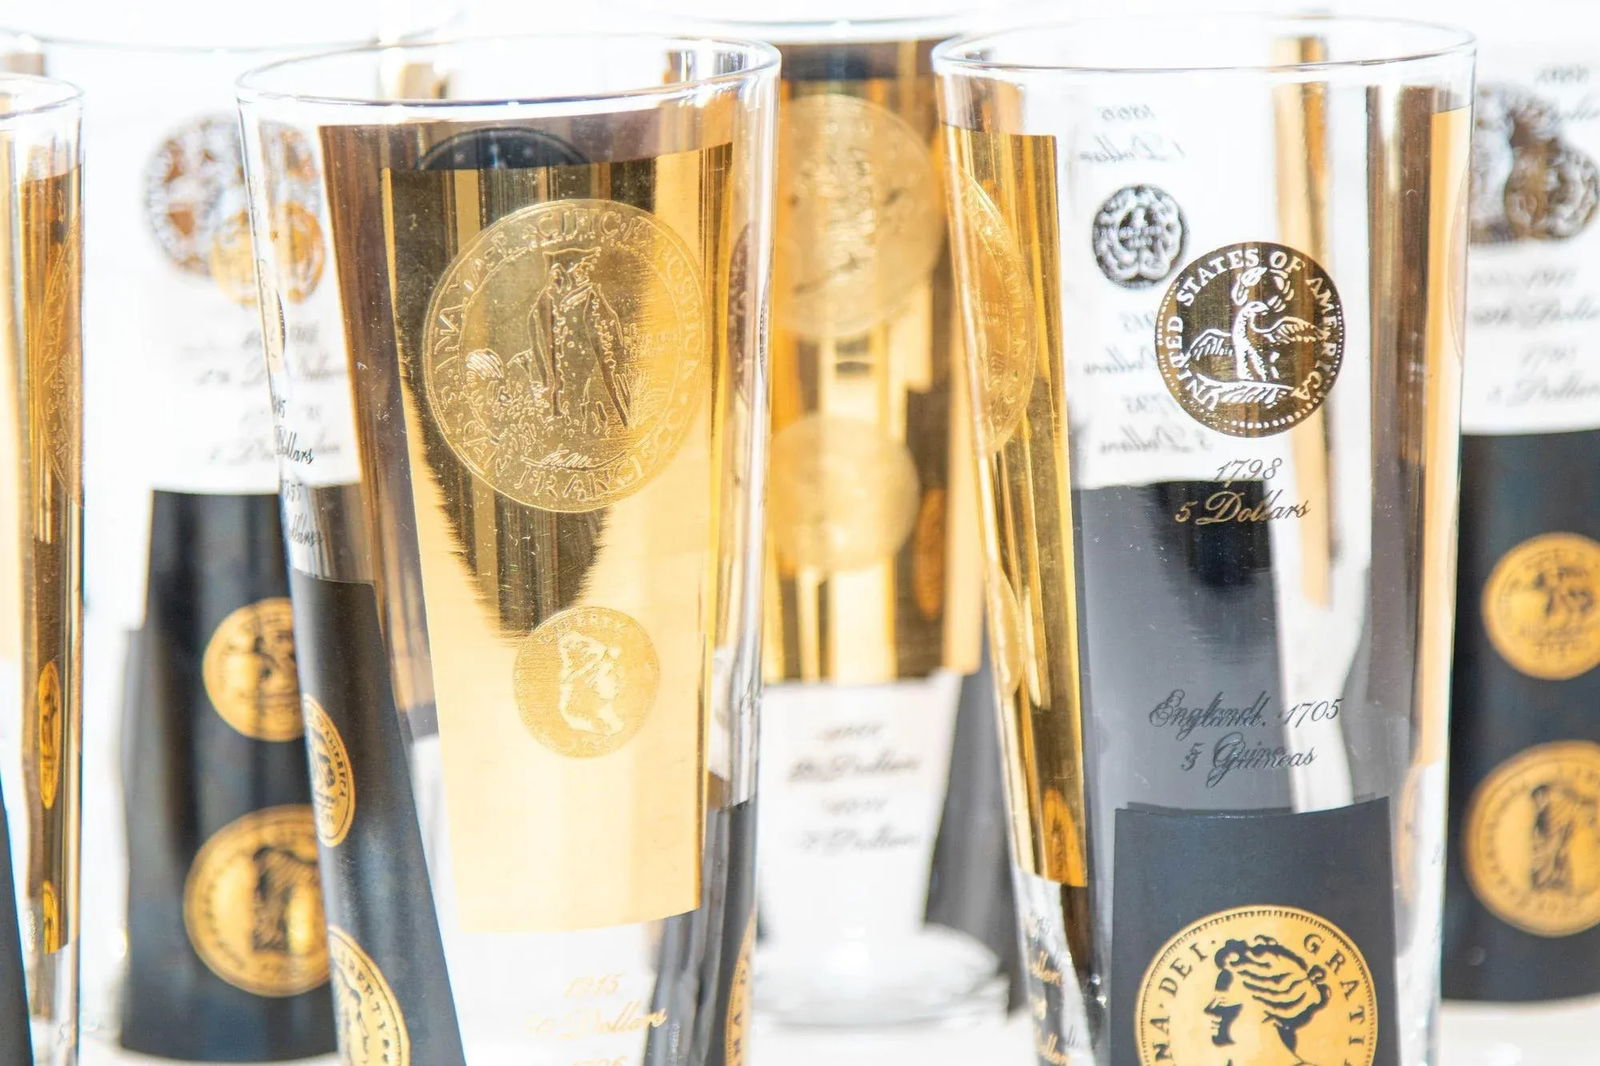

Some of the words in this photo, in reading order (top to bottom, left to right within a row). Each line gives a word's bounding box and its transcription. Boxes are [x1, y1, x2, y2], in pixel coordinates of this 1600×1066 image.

[1176, 247, 1260, 307] STATES
[1269, 250, 1306, 274] OF
[1289, 276, 1338, 401] AMERICA
[1165, 315, 1220, 412] UNITED
[1213, 457, 1283, 489] 1798
[1174, 500, 1199, 523] 5
[1195, 488, 1311, 526] Dollars
[1283, 697, 1344, 729] 1705
[1206, 731, 1317, 789] Guineas
